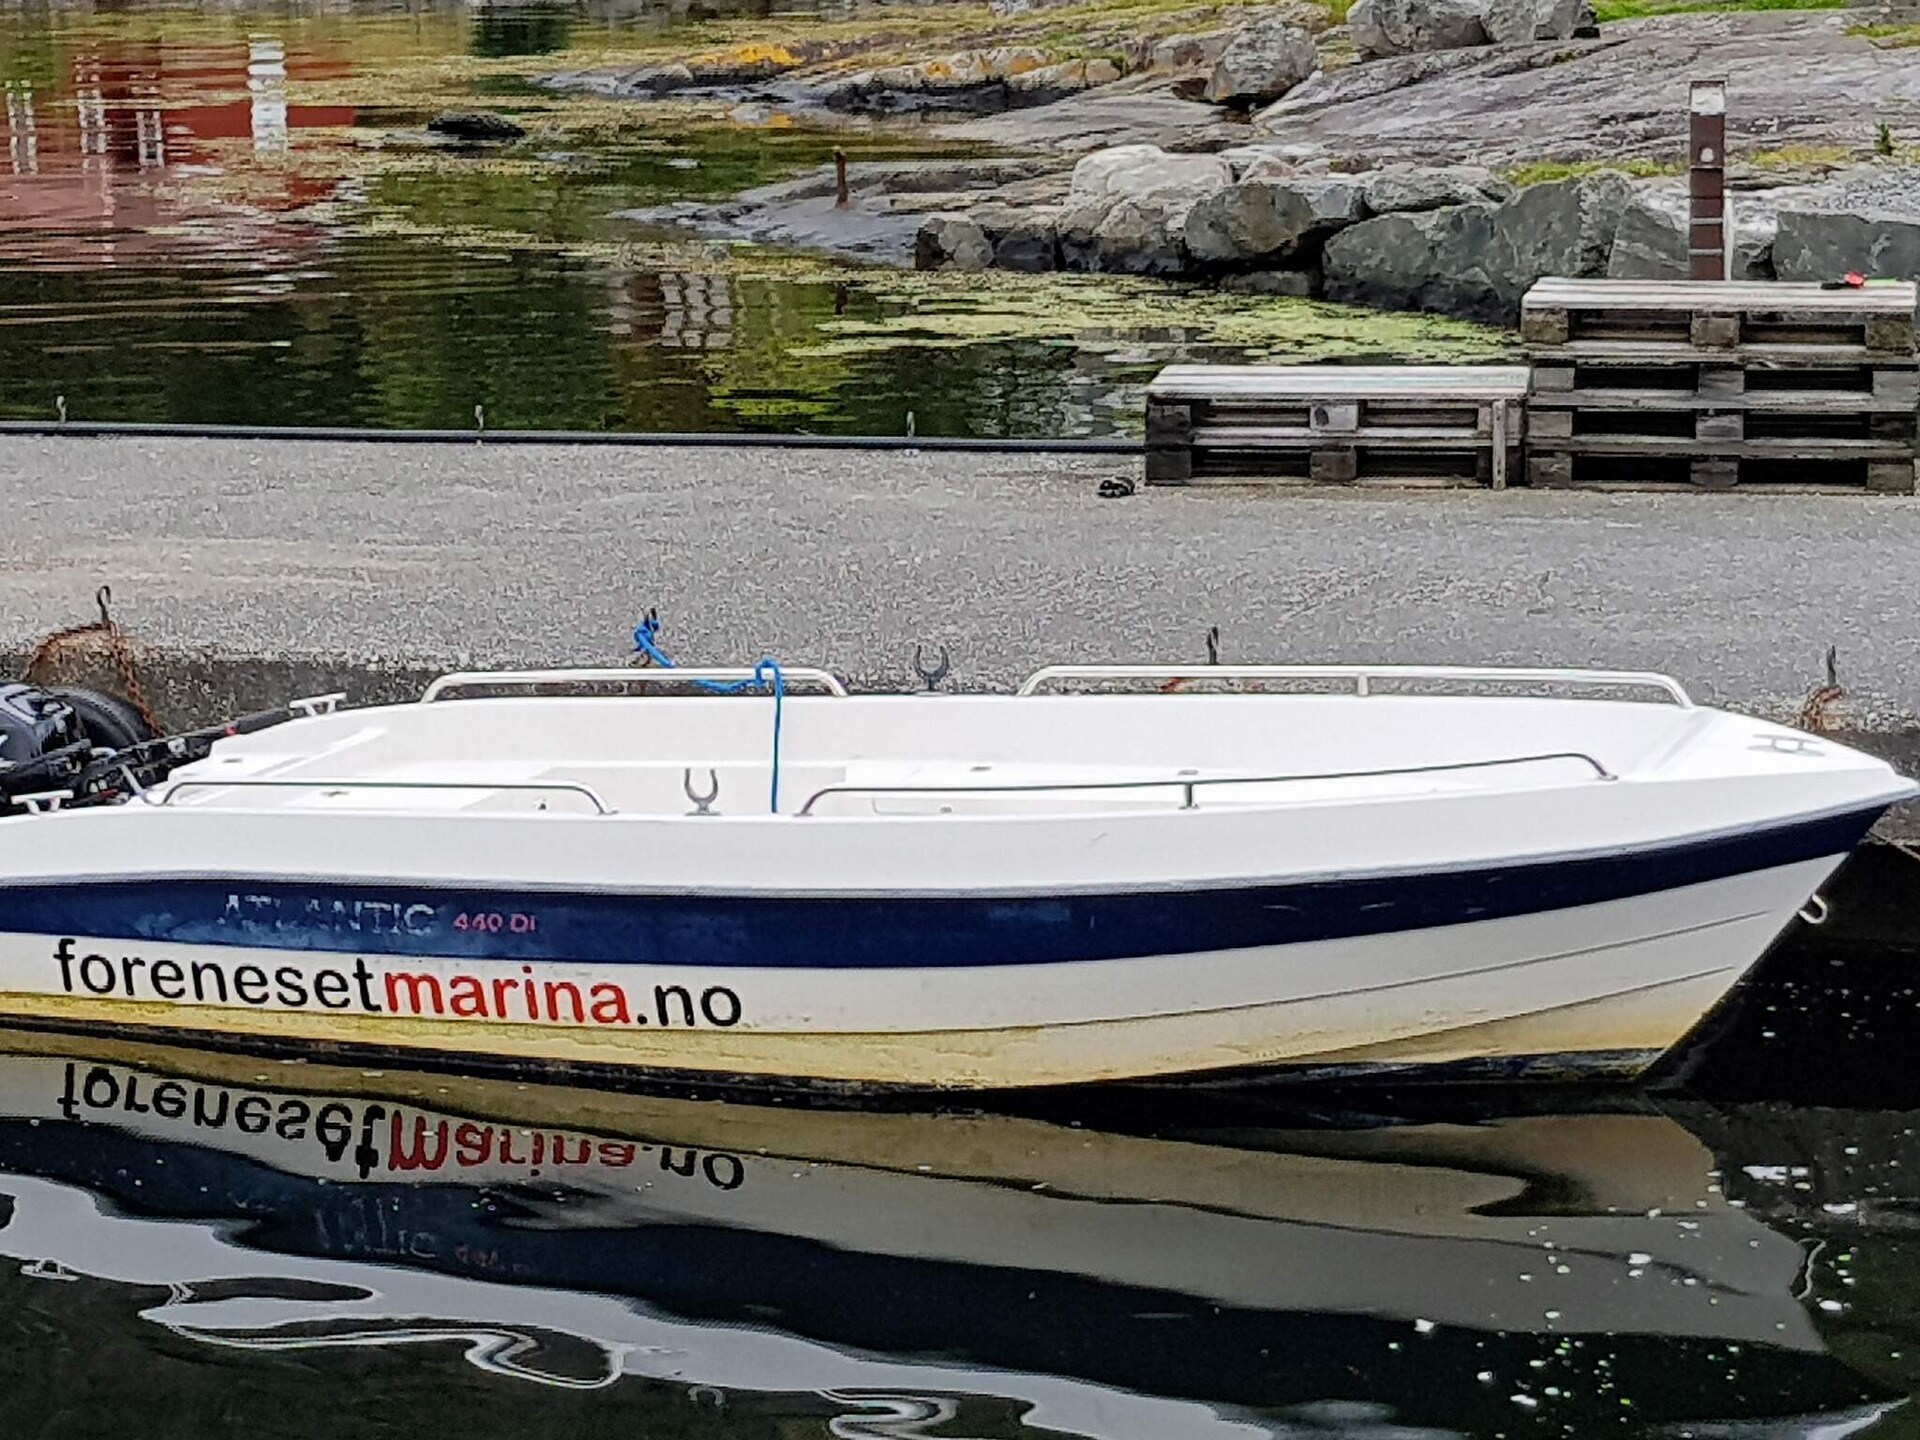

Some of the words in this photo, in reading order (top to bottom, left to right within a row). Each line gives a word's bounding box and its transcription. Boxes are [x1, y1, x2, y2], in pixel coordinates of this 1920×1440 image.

[216, 894, 436, 936] ATANTIC
[453, 912, 503, 933] 440
[53, 938, 743, 1027] forenesetmarina.no
